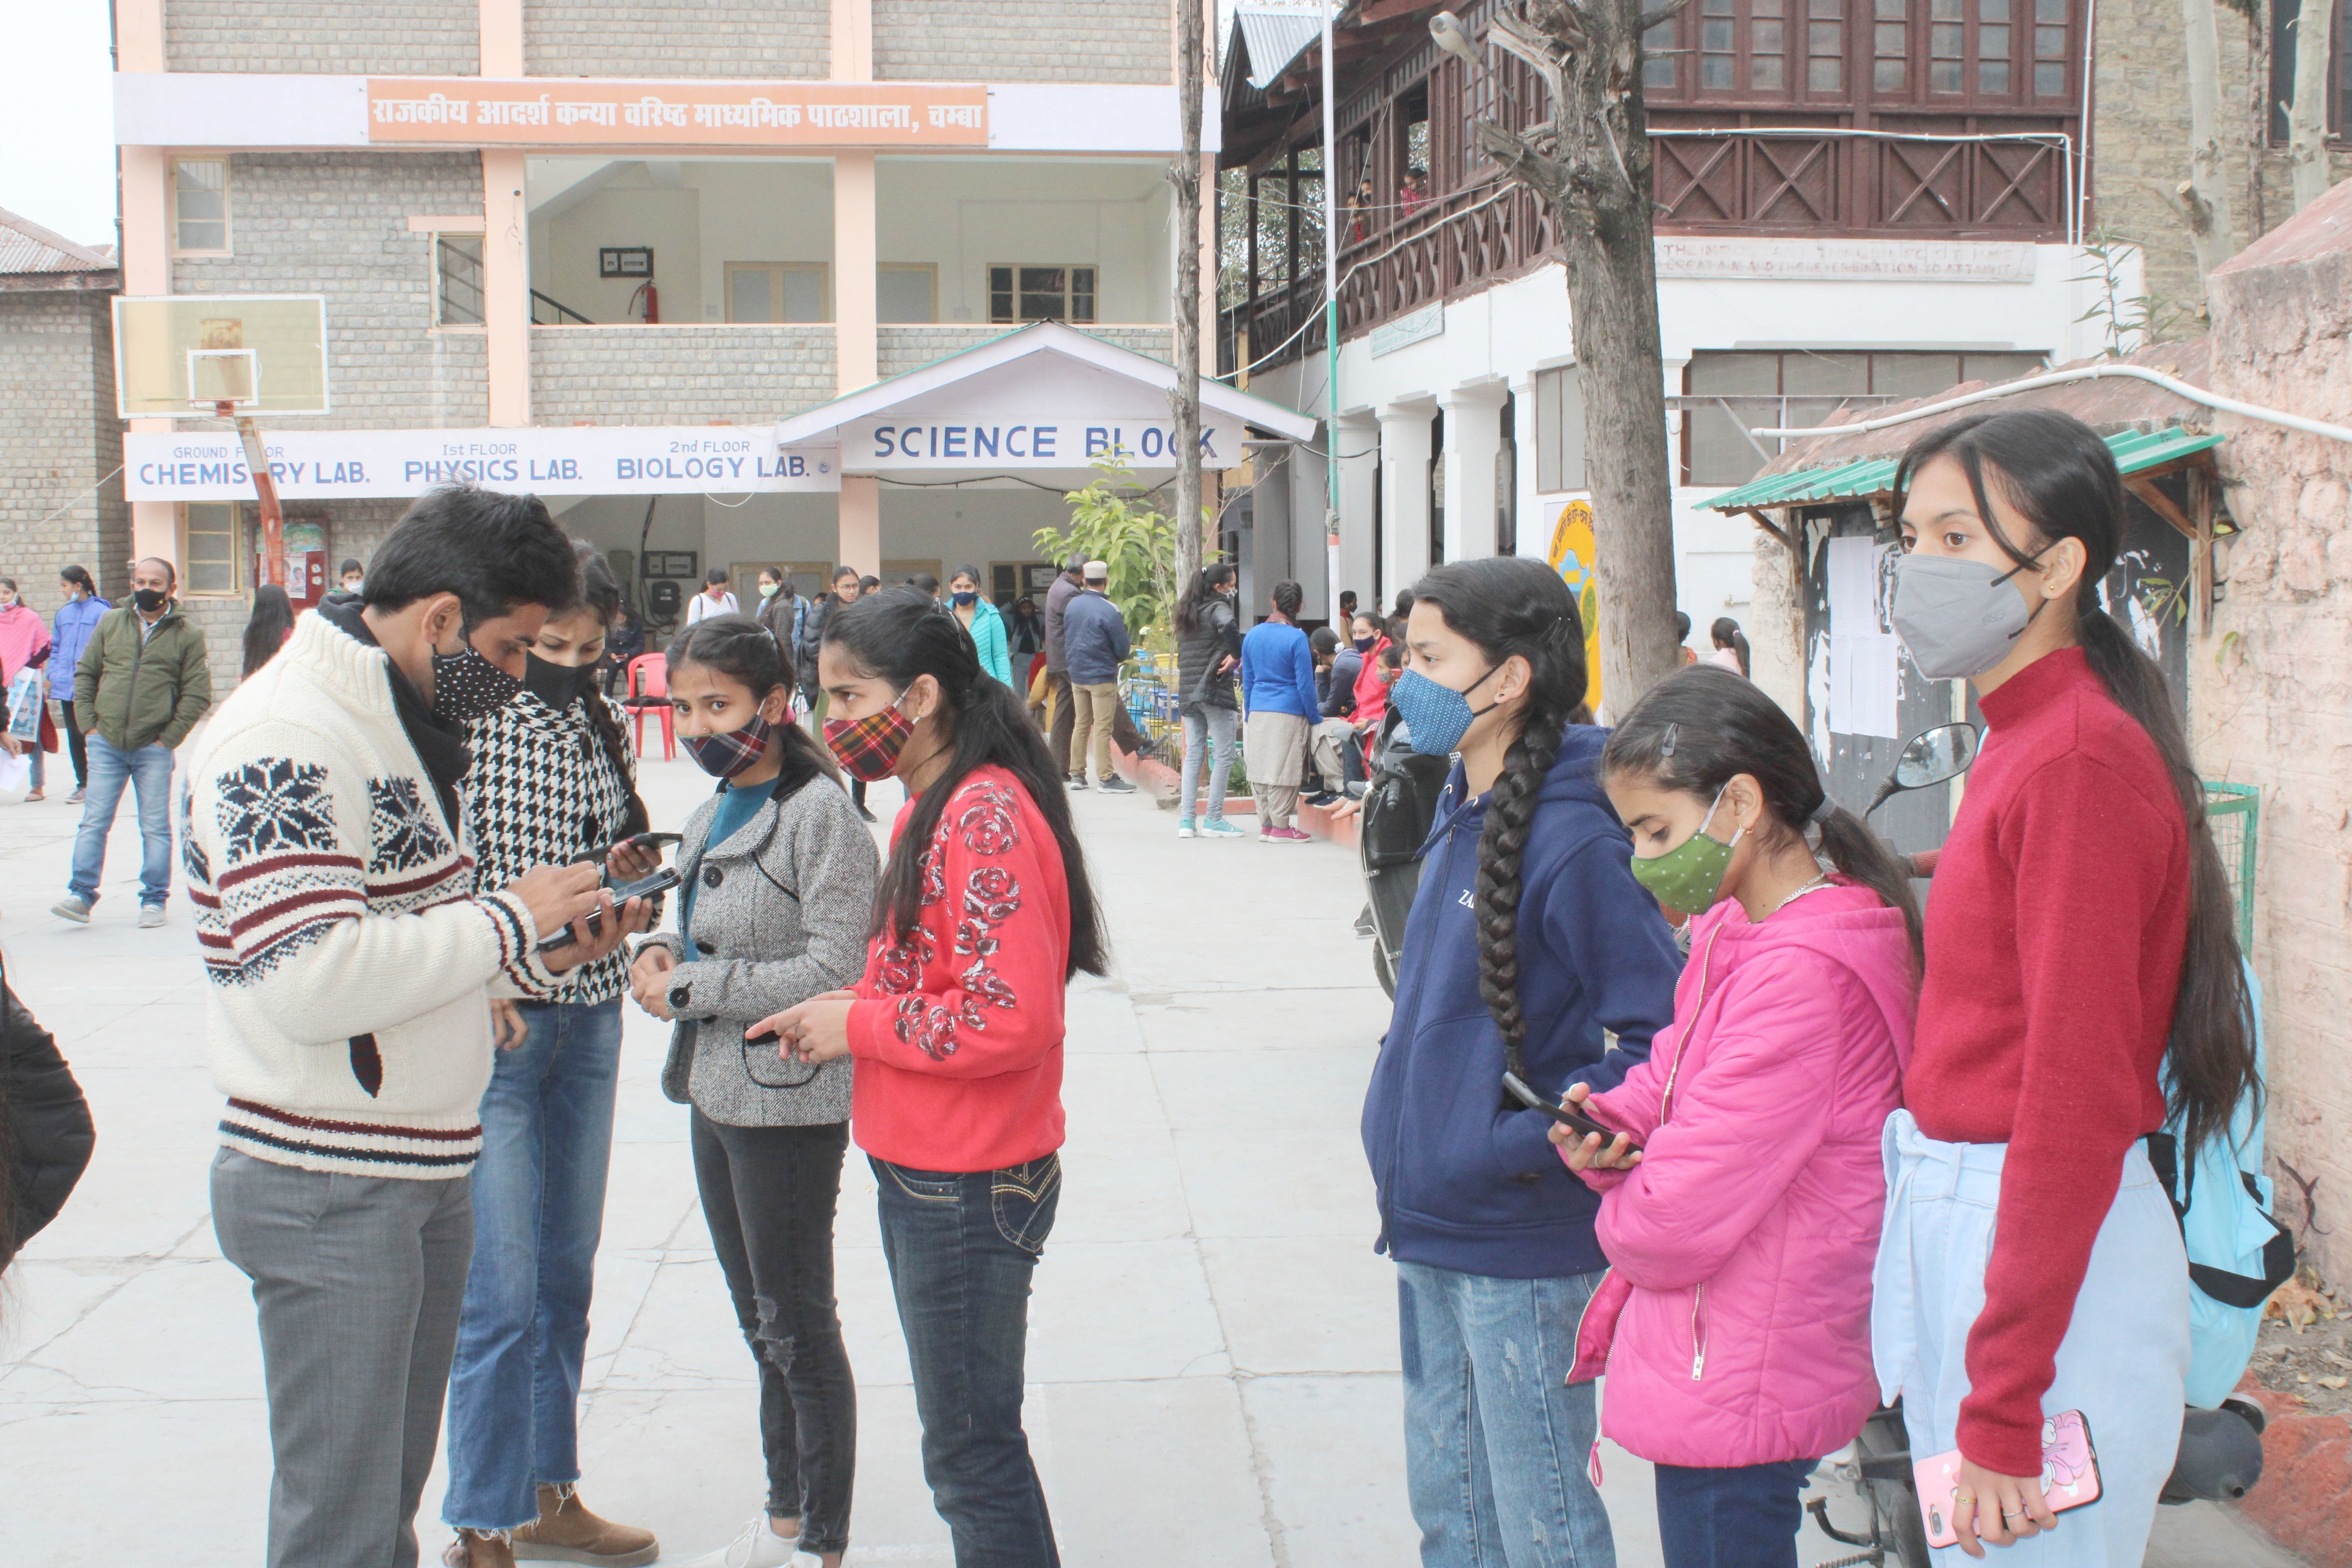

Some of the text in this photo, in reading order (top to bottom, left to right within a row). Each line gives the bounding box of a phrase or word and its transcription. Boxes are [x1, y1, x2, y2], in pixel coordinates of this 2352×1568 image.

[372, 93, 983, 133] राजकीय आदर्श कन्या वरिष्ठ माध्यमिक पाठशाला, चम्बा
[174, 446, 284, 458] GROUND FOR
[470, 443, 517, 455] FLOOR
[670, 439, 750, 453] 2nd FLOOR
[875, 426, 1057, 457] SCIENCE
[140, 461, 370, 485] CHEMISRY LAB.
[405, 459, 583, 482] PHYSICS LAB.
[617, 456, 810, 479] BIOLOGY LAB.
